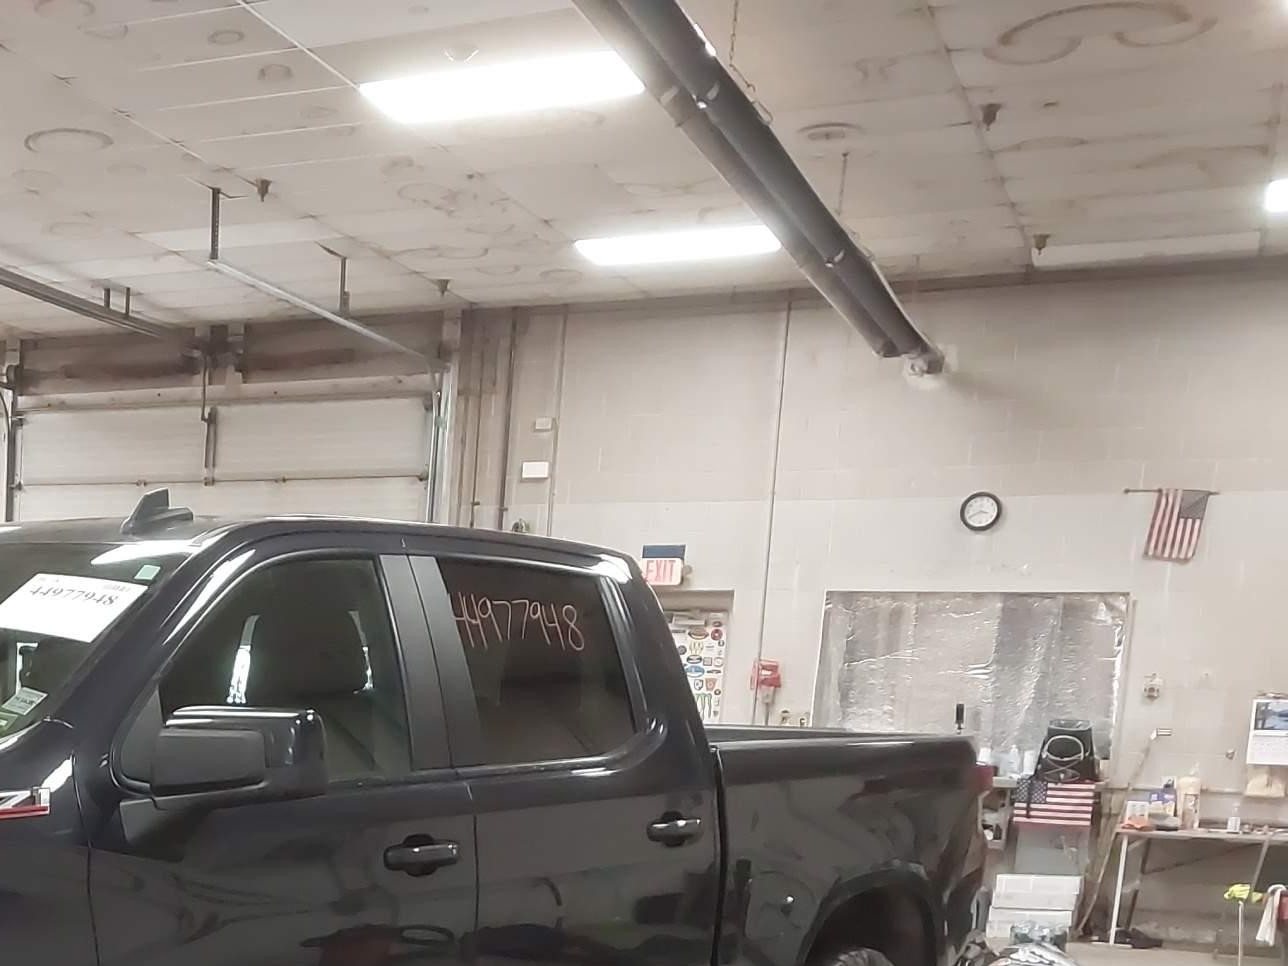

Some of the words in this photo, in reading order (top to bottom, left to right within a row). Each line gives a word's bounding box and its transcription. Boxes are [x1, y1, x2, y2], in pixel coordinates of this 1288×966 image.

[645, 559, 676, 584] EXIT
[29, 584, 119, 606] 44977948
[448, 591, 585, 651] 44977948
